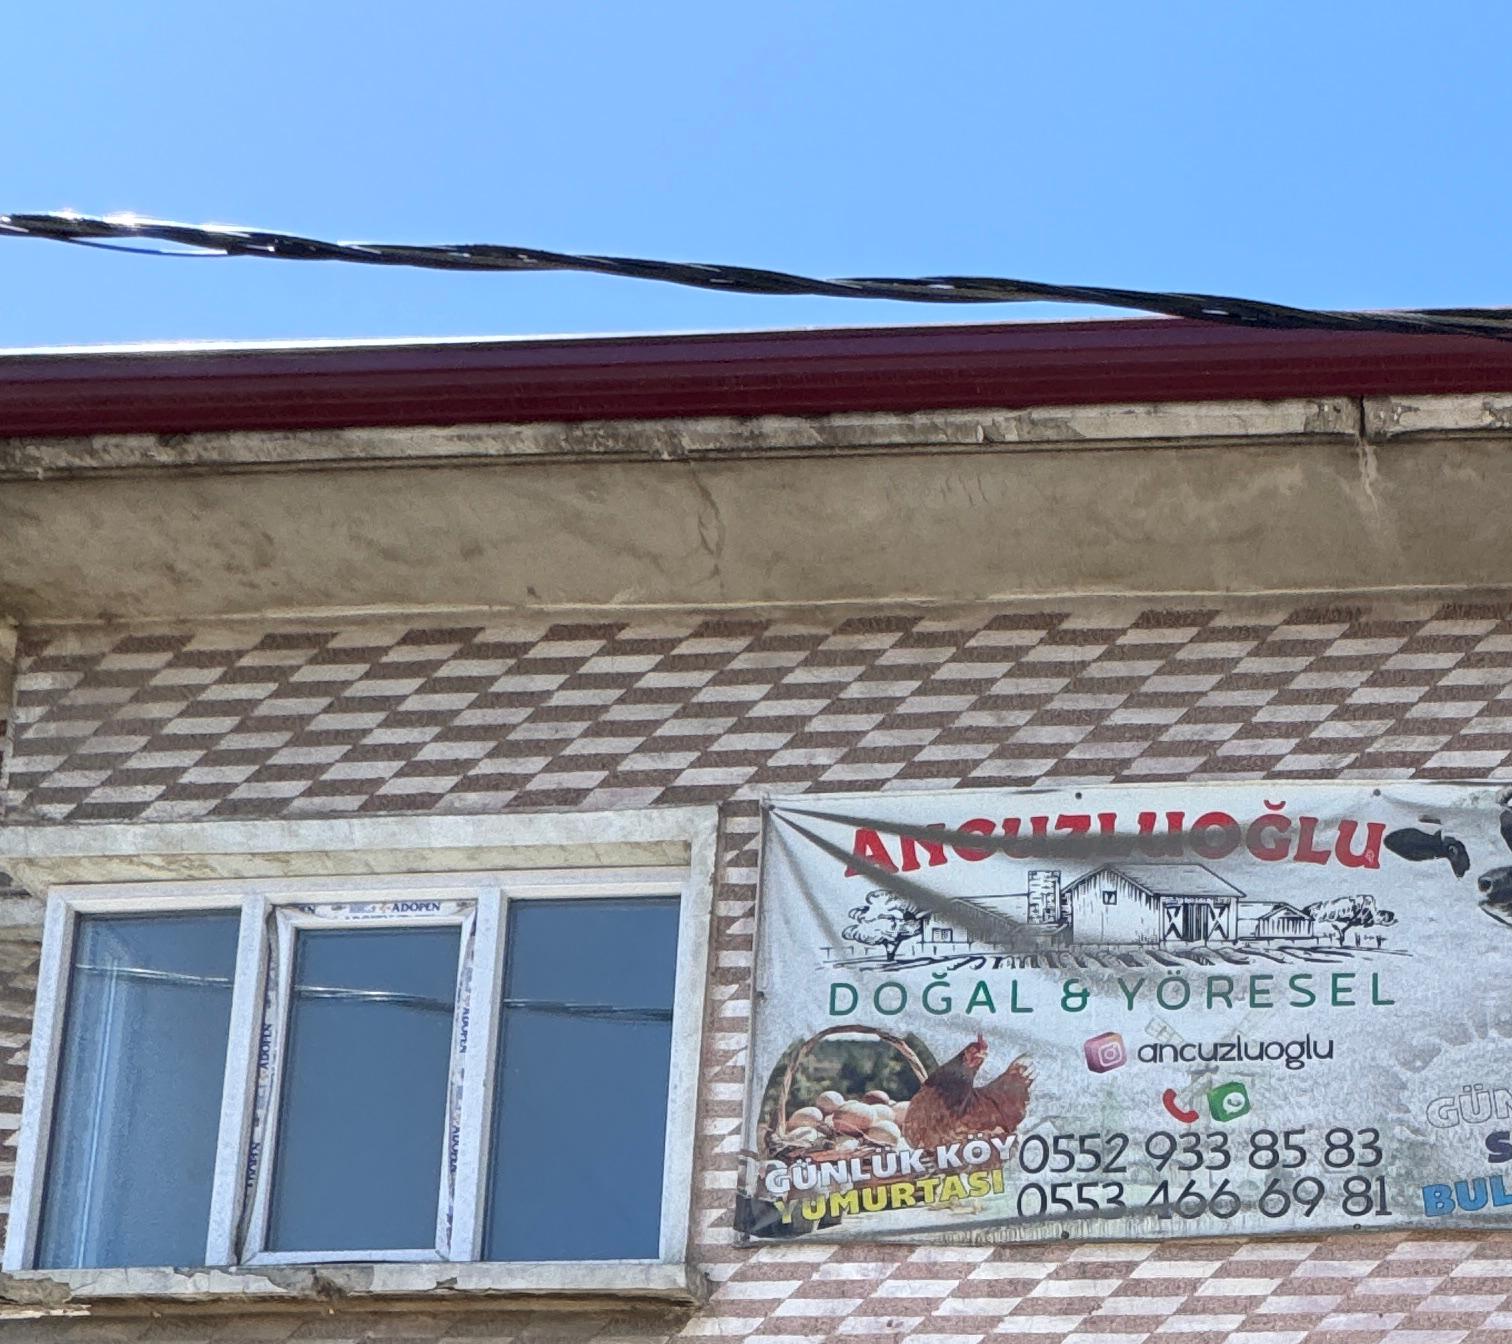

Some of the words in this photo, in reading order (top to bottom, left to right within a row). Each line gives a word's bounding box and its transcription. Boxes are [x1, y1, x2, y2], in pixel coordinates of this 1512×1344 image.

[829, 973, 1033, 1017] DOĞAL
[1060, 981, 1090, 1011] &
[1118, 970, 1396, 1011] YÖRESEL
[1137, 1034, 1334, 1069] ancuzluoglu
[764, 1146, 936, 1195] GÜNLÜK
[936, 1133, 1018, 1169] KÖY
[1018, 1132, 1130, 1173] 0552
[1145, 1130, 1232, 1172] 933
[1248, 1128, 1307, 1171] 85
[1324, 1128, 1384, 1169] 83
[775, 1168, 1006, 1225] YUMURTASI
[1016, 1183, 1126, 1219] 0553
[1145, 1179, 1242, 1219] 466
[1258, 1175, 1326, 1218] 69
[1341, 1175, 1392, 1217] 81
